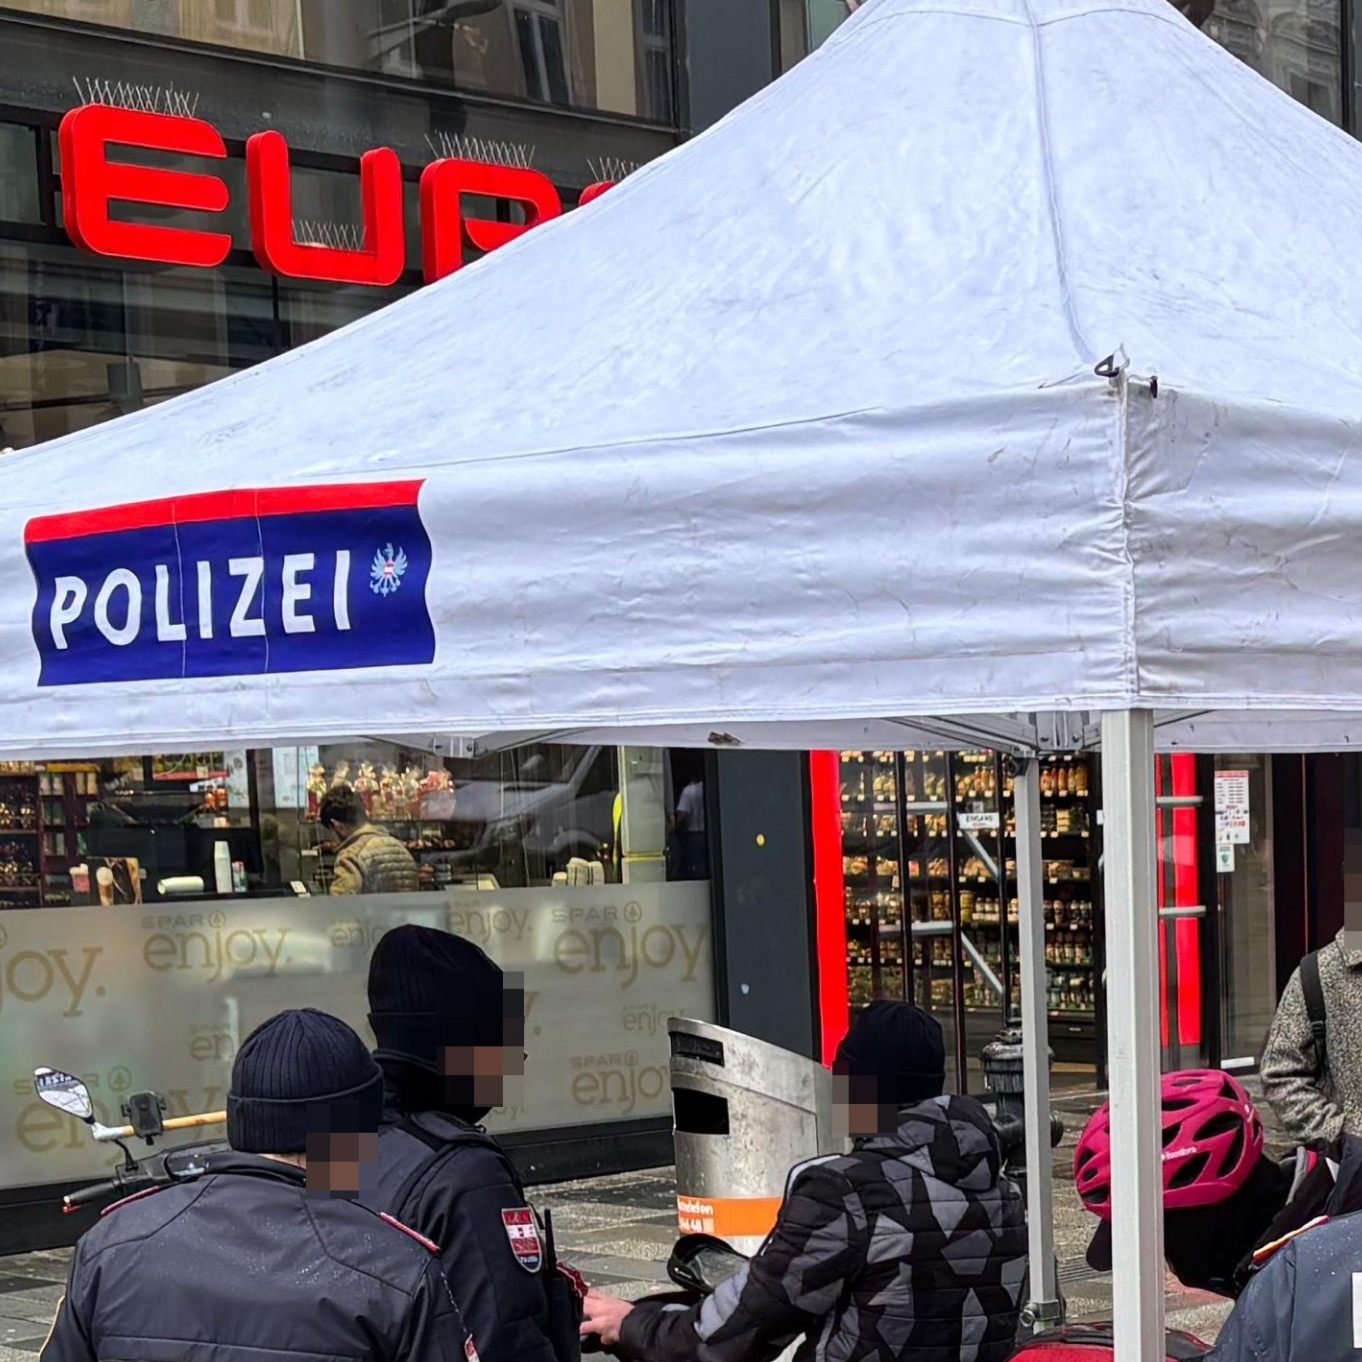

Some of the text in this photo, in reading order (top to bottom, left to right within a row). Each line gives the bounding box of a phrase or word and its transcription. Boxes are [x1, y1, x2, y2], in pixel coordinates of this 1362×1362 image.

[58, 102, 618, 287] EUR
[49, 549, 352, 651] POLIZEI
[141, 914, 205, 930] SPAR
[551, 906, 618, 923] SPAR
